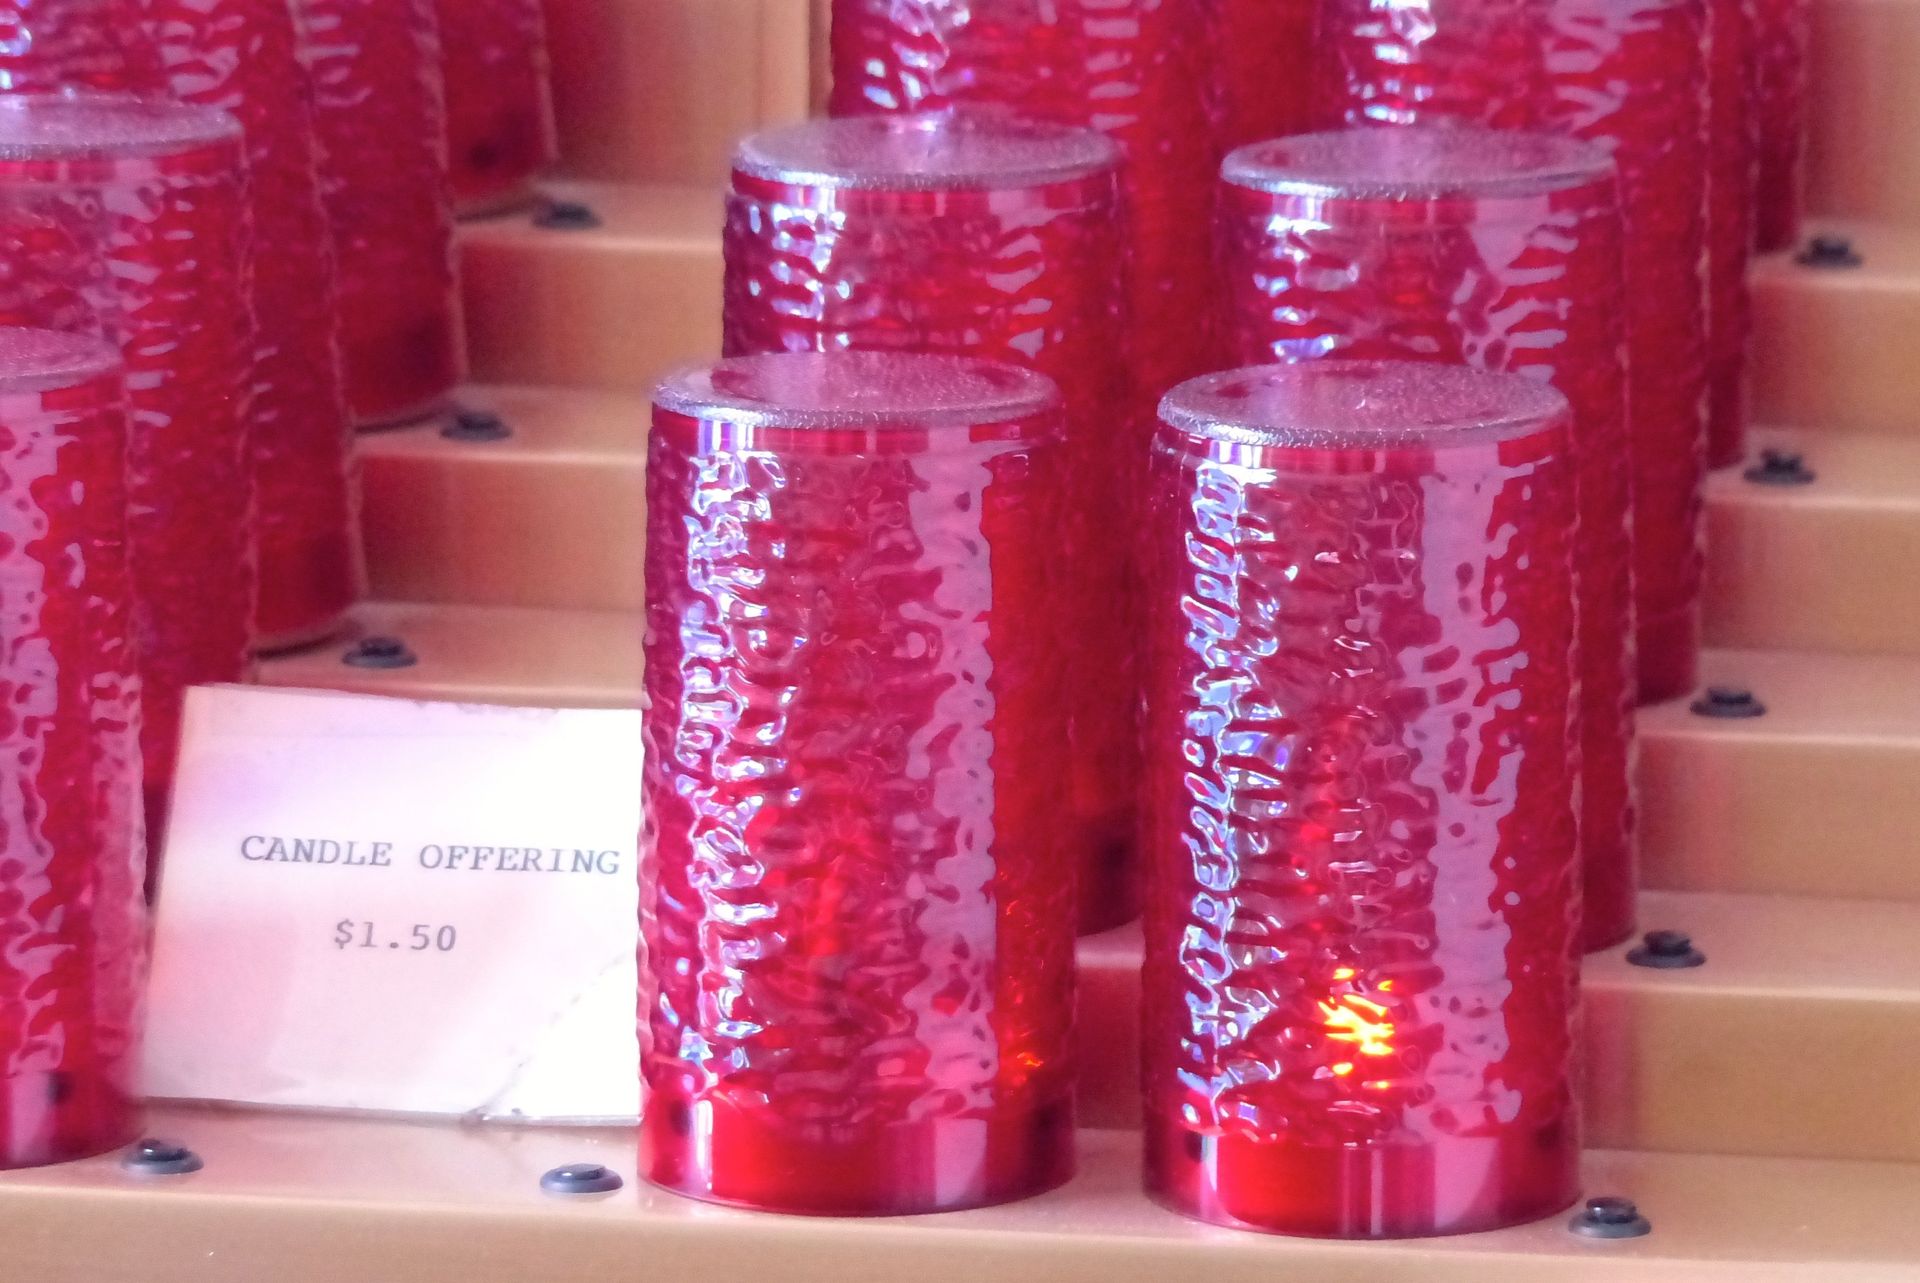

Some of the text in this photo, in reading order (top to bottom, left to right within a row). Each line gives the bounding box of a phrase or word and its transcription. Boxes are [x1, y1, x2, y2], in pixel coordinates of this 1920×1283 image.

[240, 835, 621, 875] CANDLE OFFERING
[333, 918, 457, 952] $1.50
